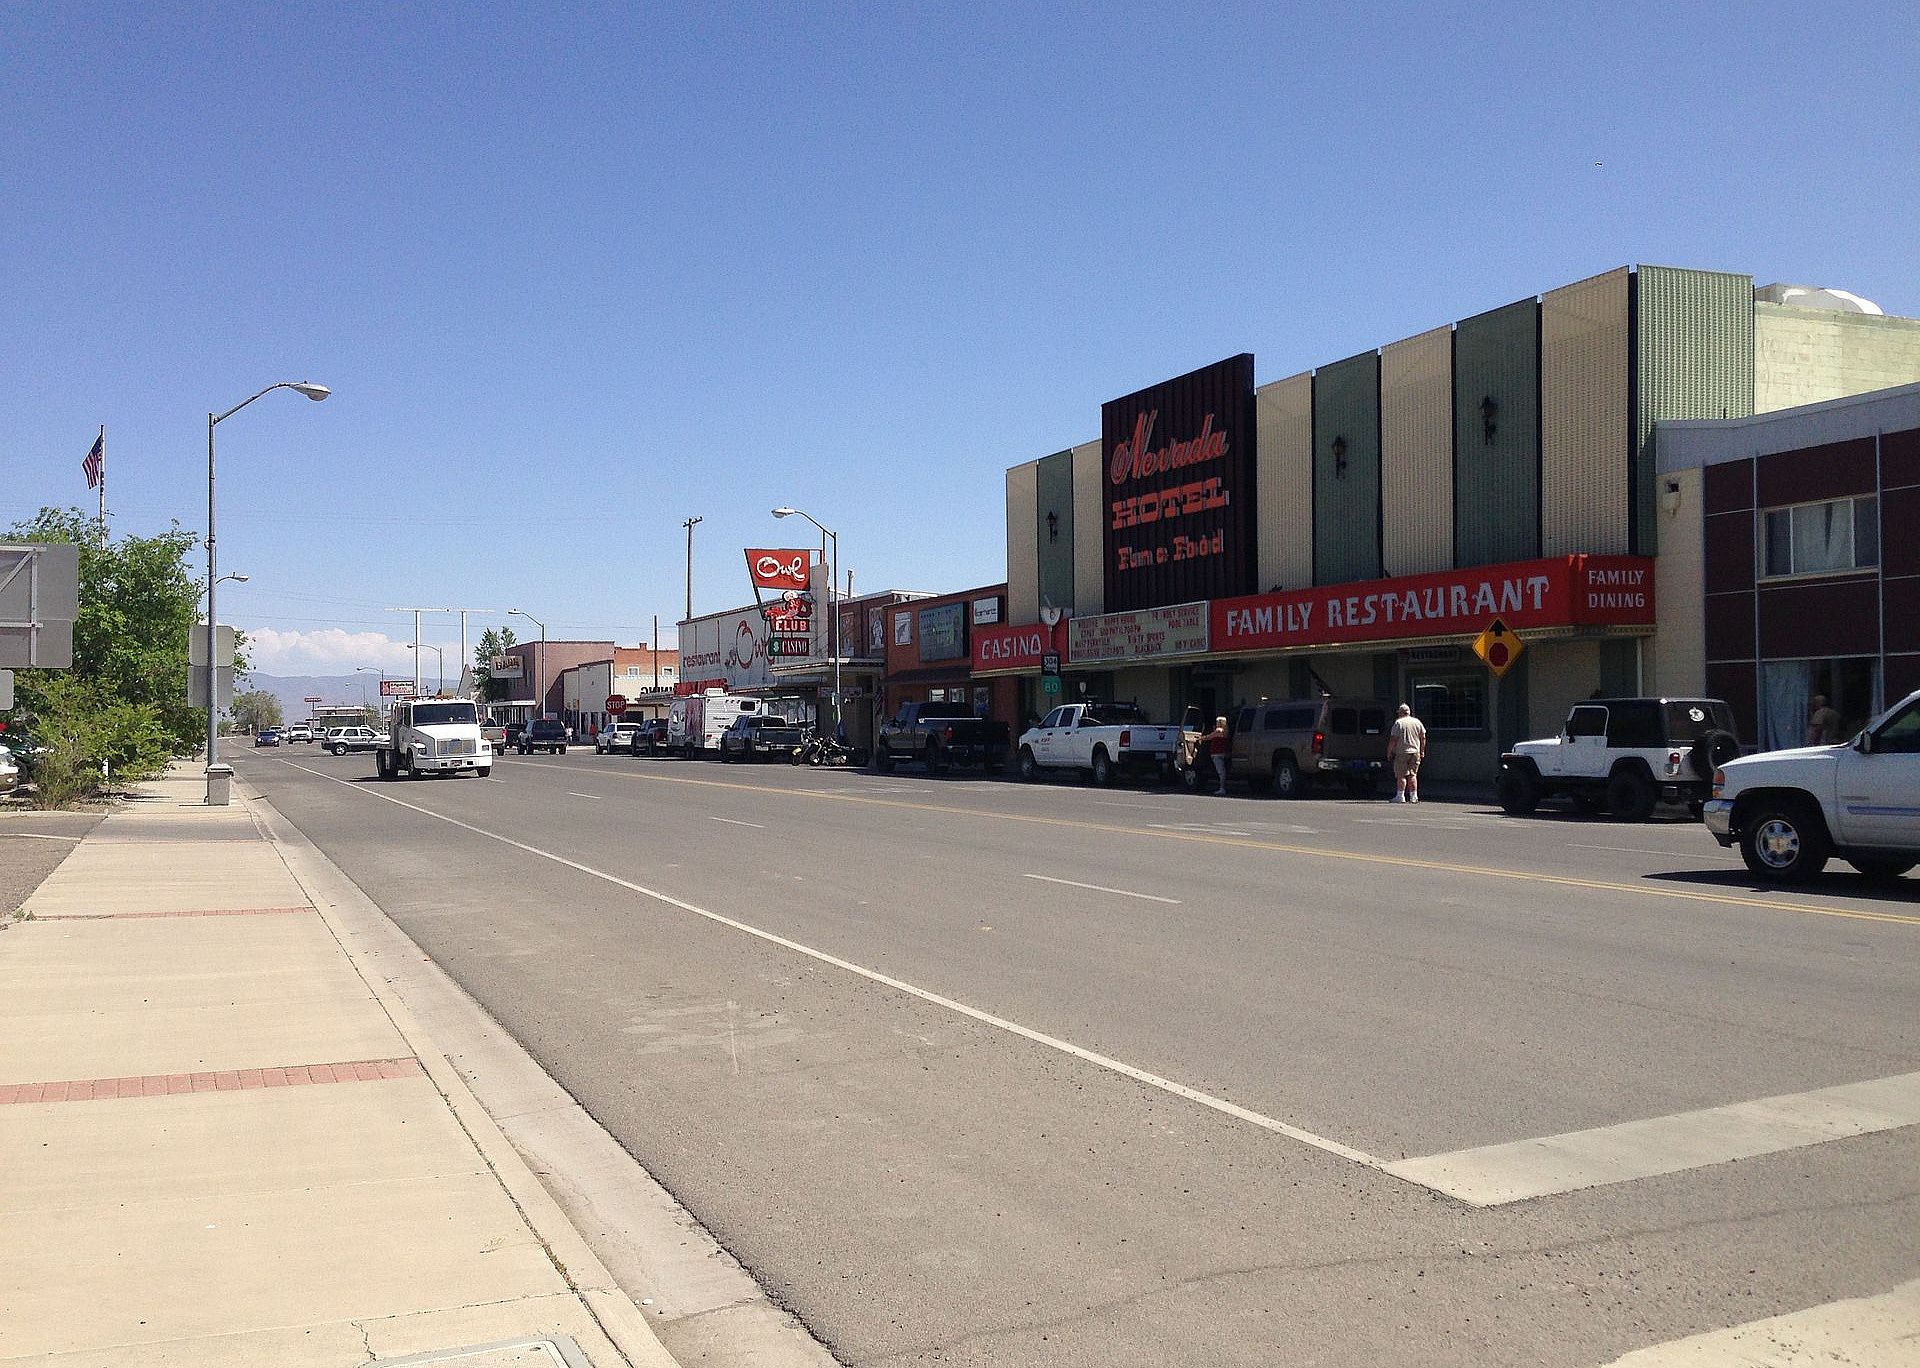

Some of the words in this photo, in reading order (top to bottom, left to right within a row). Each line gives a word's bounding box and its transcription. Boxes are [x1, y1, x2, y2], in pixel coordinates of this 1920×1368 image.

[1111, 410, 1229, 484] Nevada
[1113, 477, 1229, 529] HOTEL
[1173, 528, 1223, 561] Food
[756, 556, 805, 581] Owl
[1588, 569, 1645, 587] FAMILY
[1227, 602, 1313, 637] FAMILY
[1327, 575, 1550, 626] RESTAURANT
[1588, 592, 1645, 609] DINING
[775, 619, 807, 632] CLUB
[781, 640, 808, 653] CASINO
[981, 633, 1042, 660] CASINO
[606, 700, 626, 709] STOP
